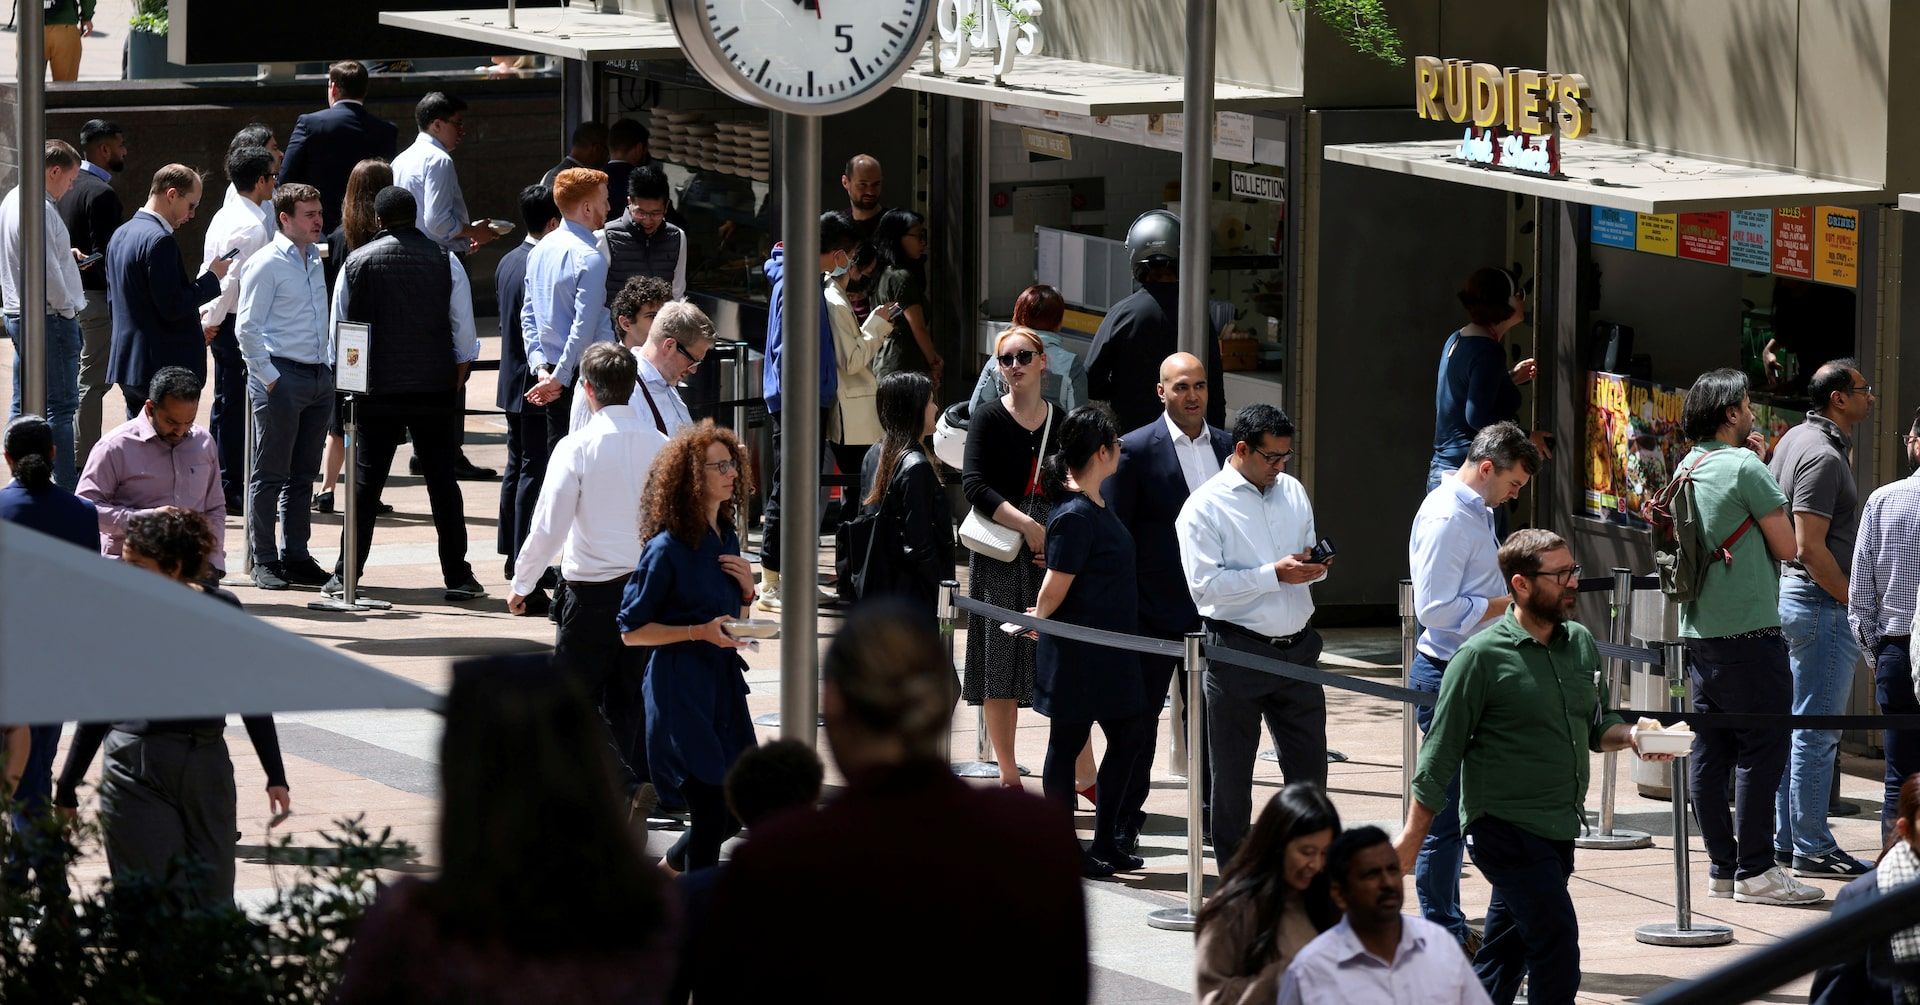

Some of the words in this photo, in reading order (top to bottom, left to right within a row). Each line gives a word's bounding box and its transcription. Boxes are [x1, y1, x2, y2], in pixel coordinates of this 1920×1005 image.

[834, 24, 854, 53] 5
[937, 0, 1043, 76] guys
[1415, 56, 1593, 139] RUDIE'S
[1234, 173, 1286, 199] COLLECTION
[1827, 214, 1856, 230] DRINKS
